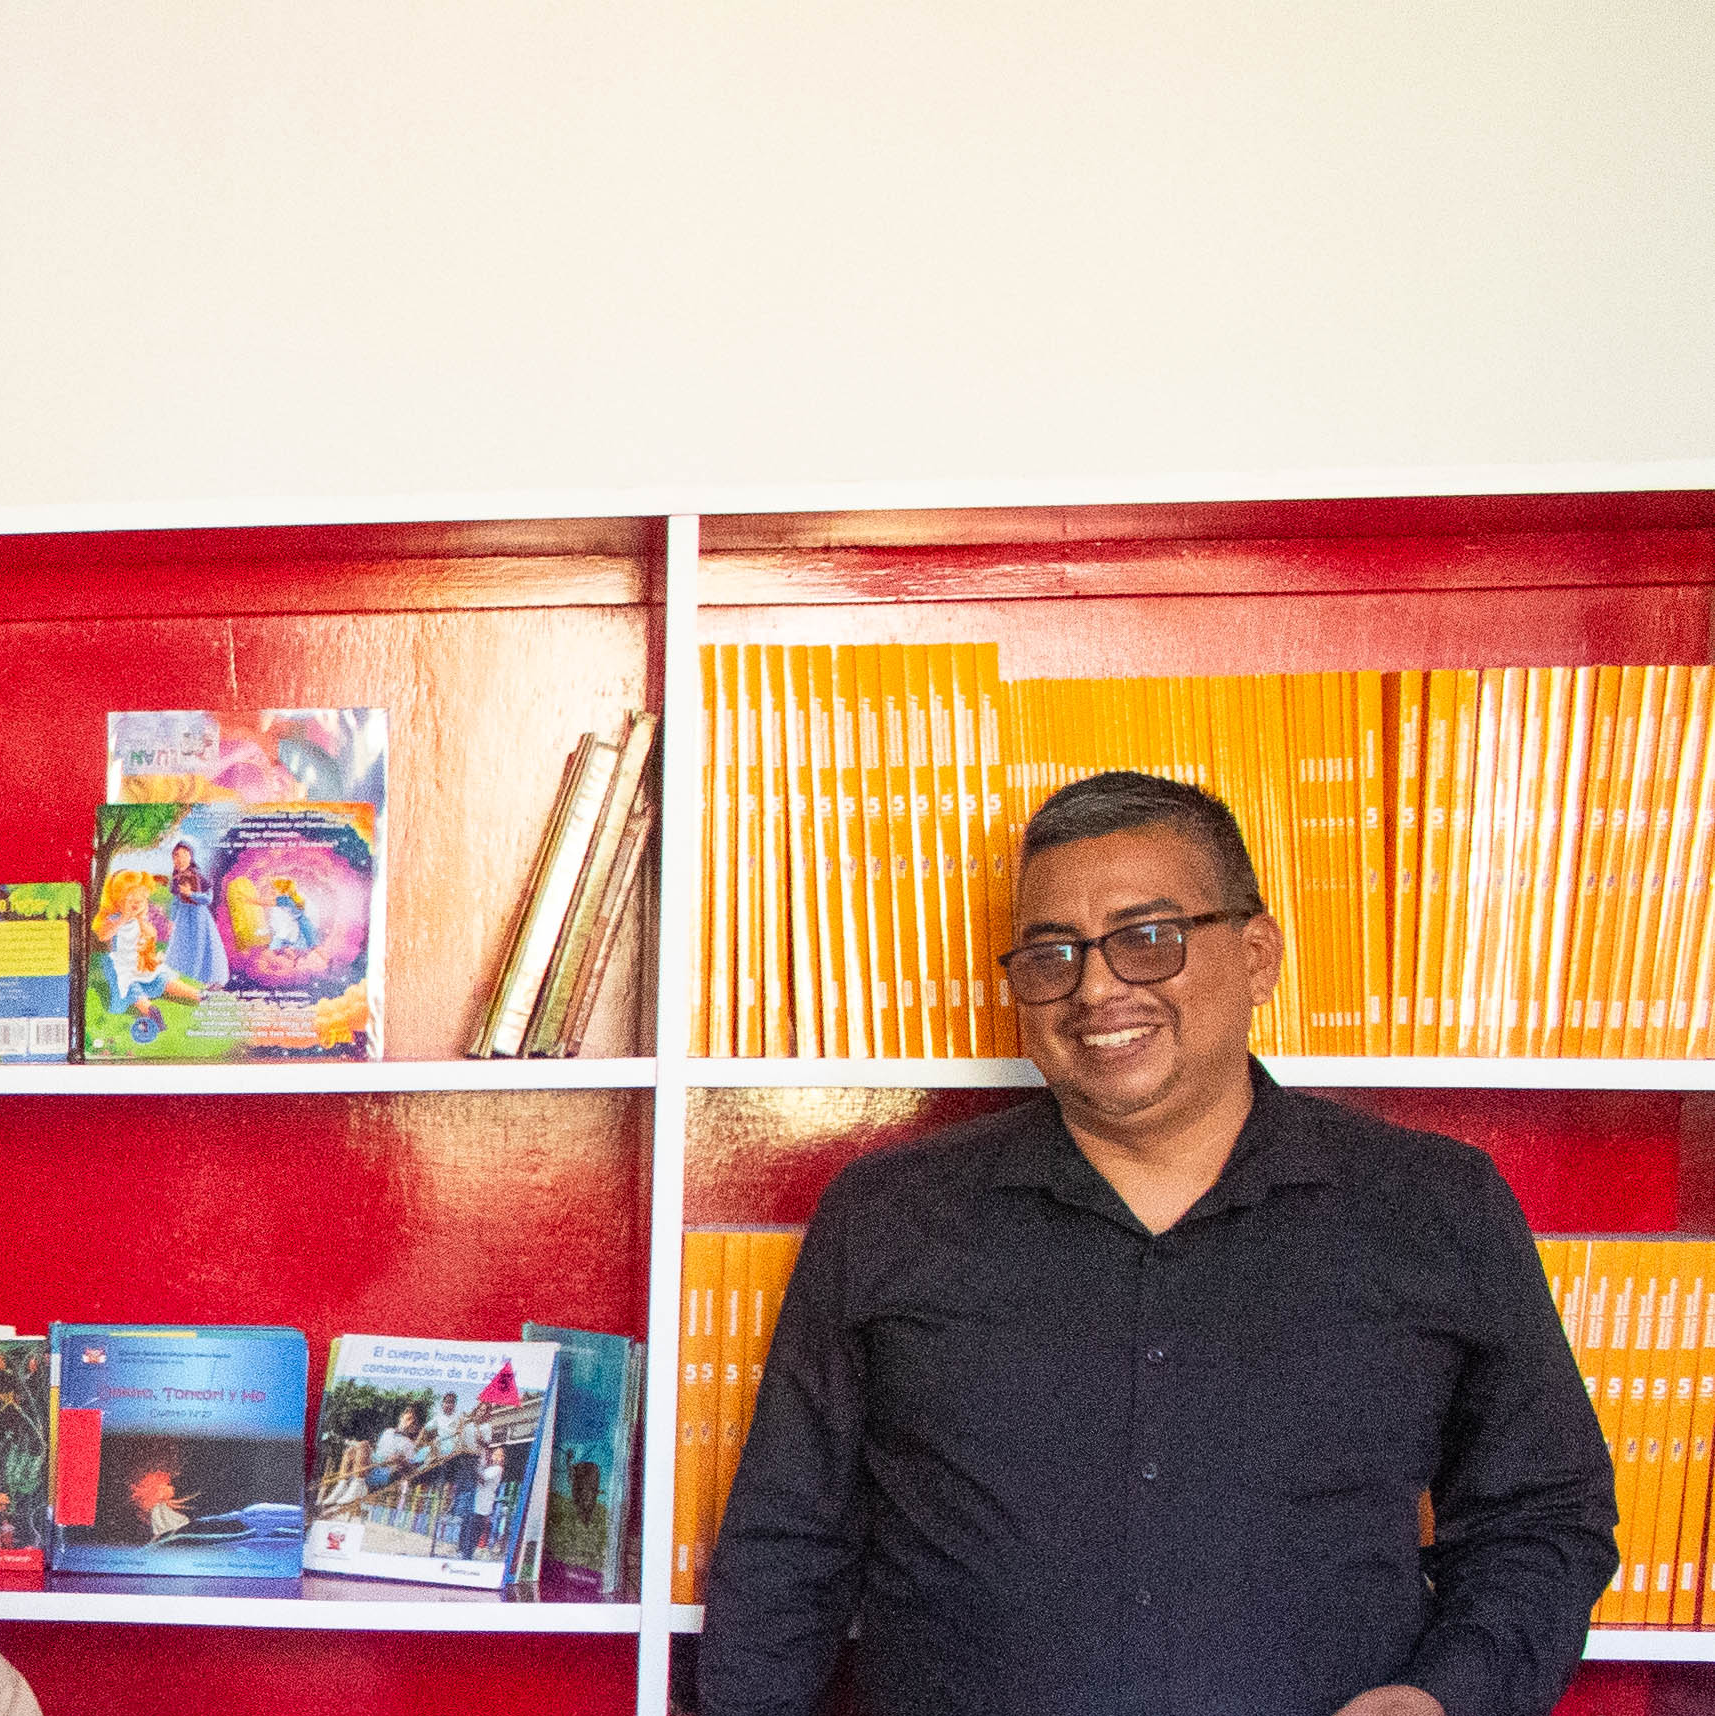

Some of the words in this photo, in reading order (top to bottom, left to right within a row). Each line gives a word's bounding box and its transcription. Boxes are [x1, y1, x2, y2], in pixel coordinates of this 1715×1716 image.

[387, 1349, 430, 1362] cuerpo
[434, 1350, 486, 1364] humano
[446, 1366, 462, 1379] de
[685, 1363, 697, 1381] 5
[726, 1363, 738, 1381] 5
[1607, 1376, 1621, 1394] 5
[1631, 1377, 1645, 1394] 5
[1652, 1377, 1666, 1394] 5
[1677, 1377, 1691, 1394] 5
[1700, 1376, 1714, 1394] 5
